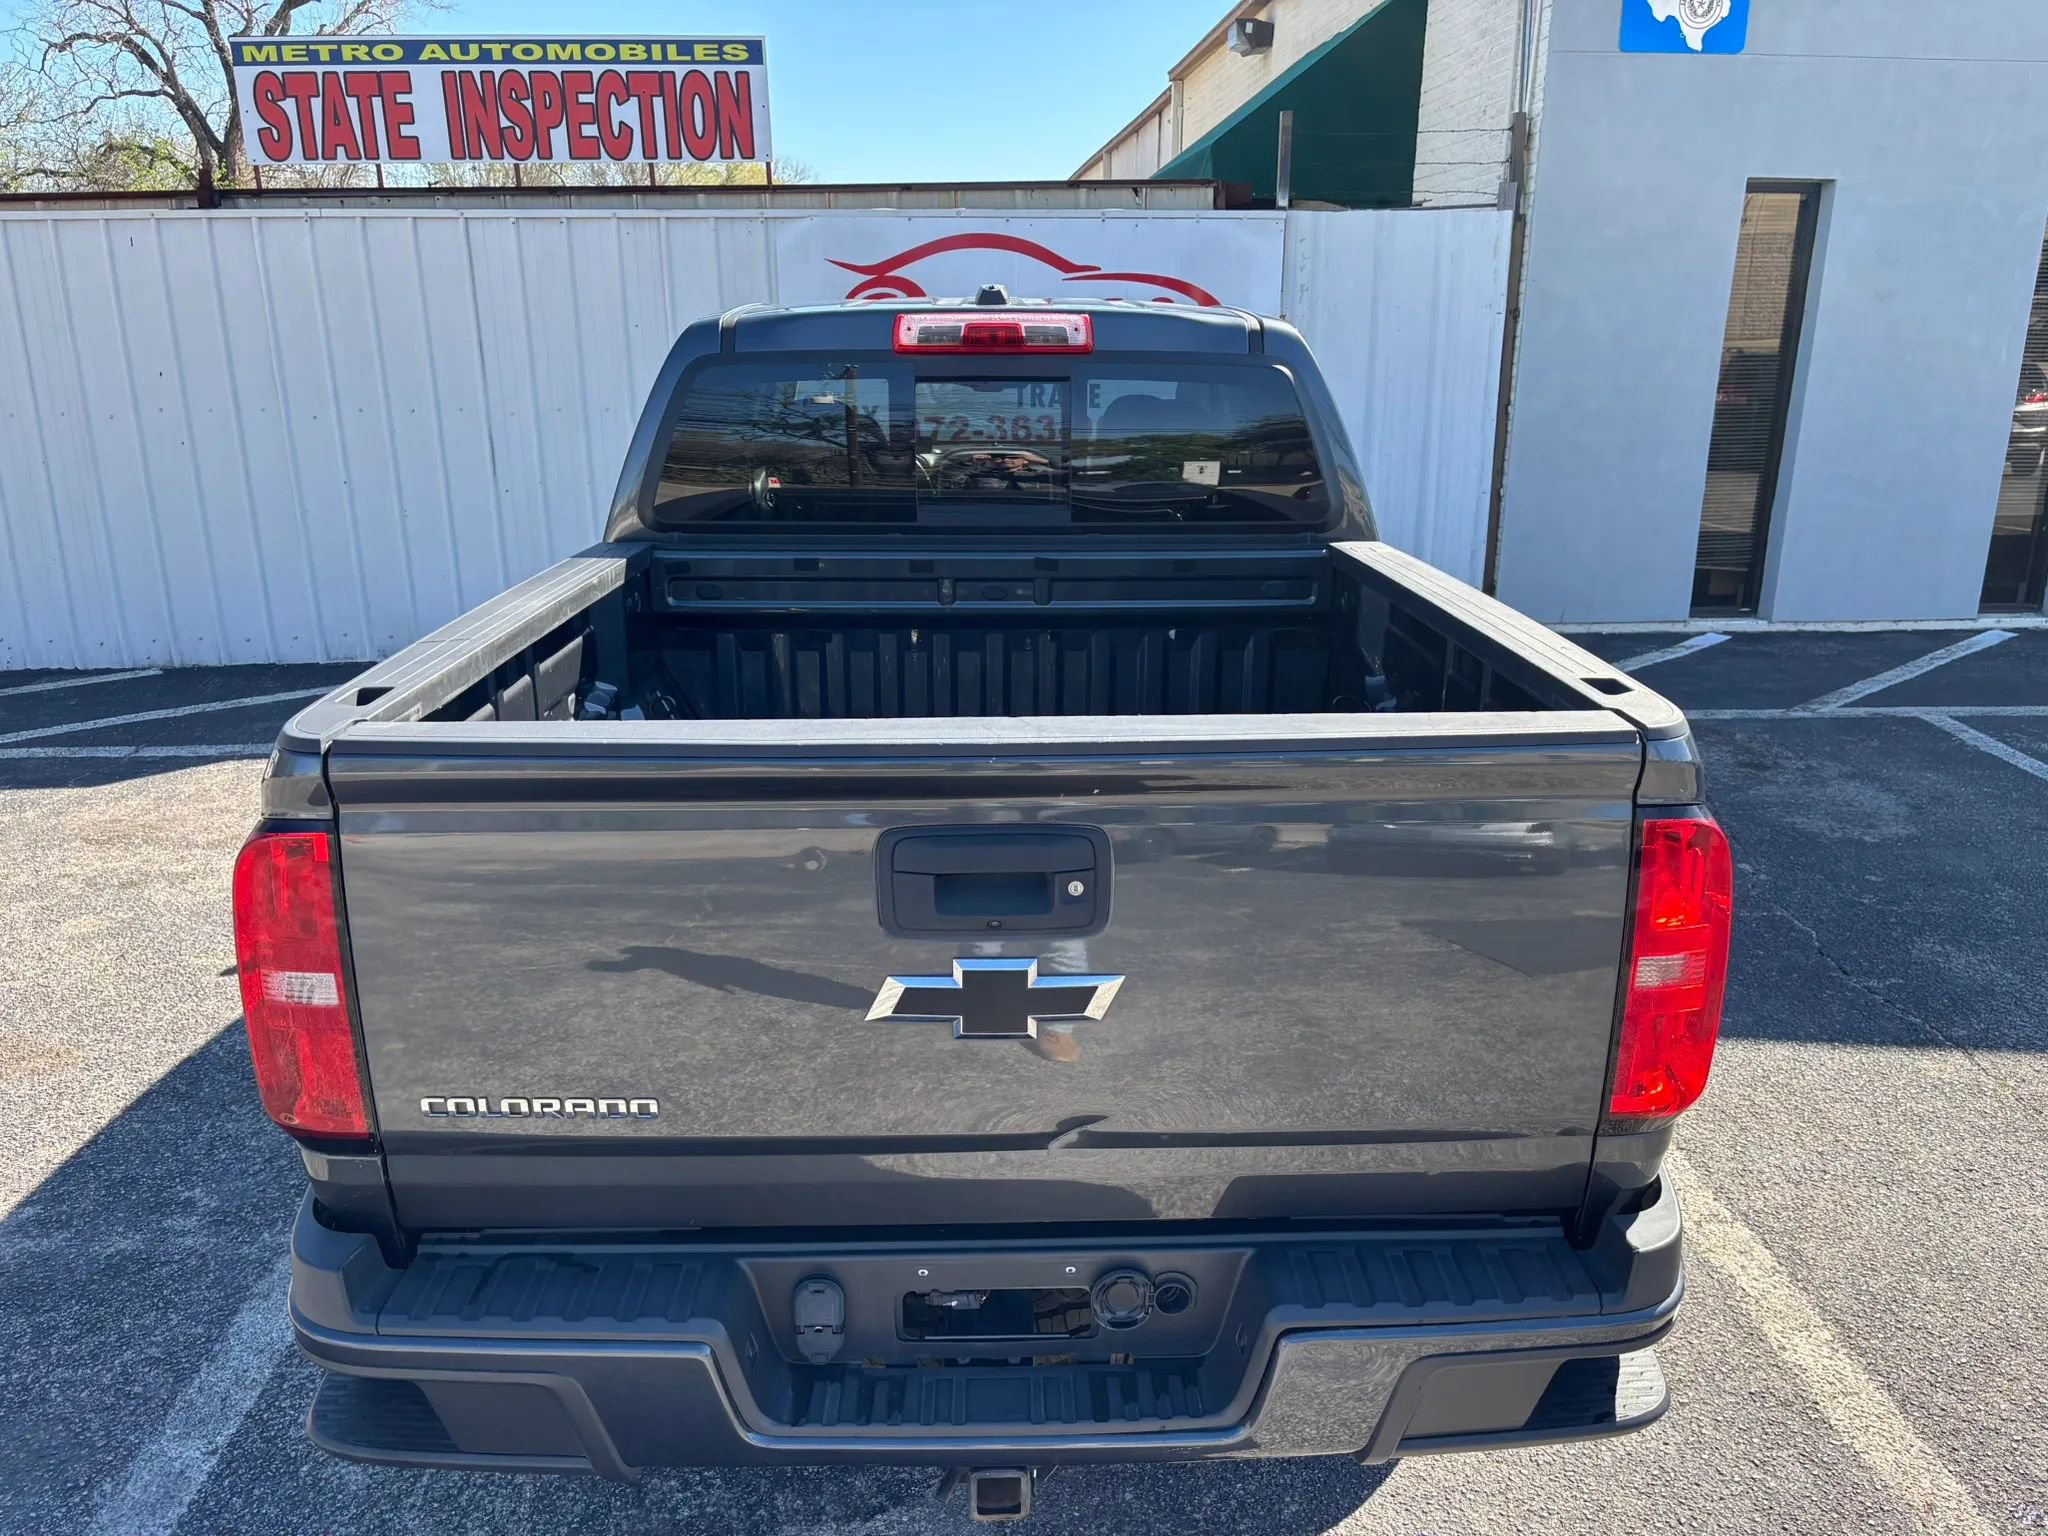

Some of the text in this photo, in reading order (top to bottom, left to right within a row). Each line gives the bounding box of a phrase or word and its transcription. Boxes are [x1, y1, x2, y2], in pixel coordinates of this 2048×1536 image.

[241, 43, 751, 62] METRO AUTOMOBILES
[253, 69, 755, 162] STATE INSPECTION
[1016, 383, 1101, 409] TRAE
[420, 1096, 660, 1119] COLORADO
